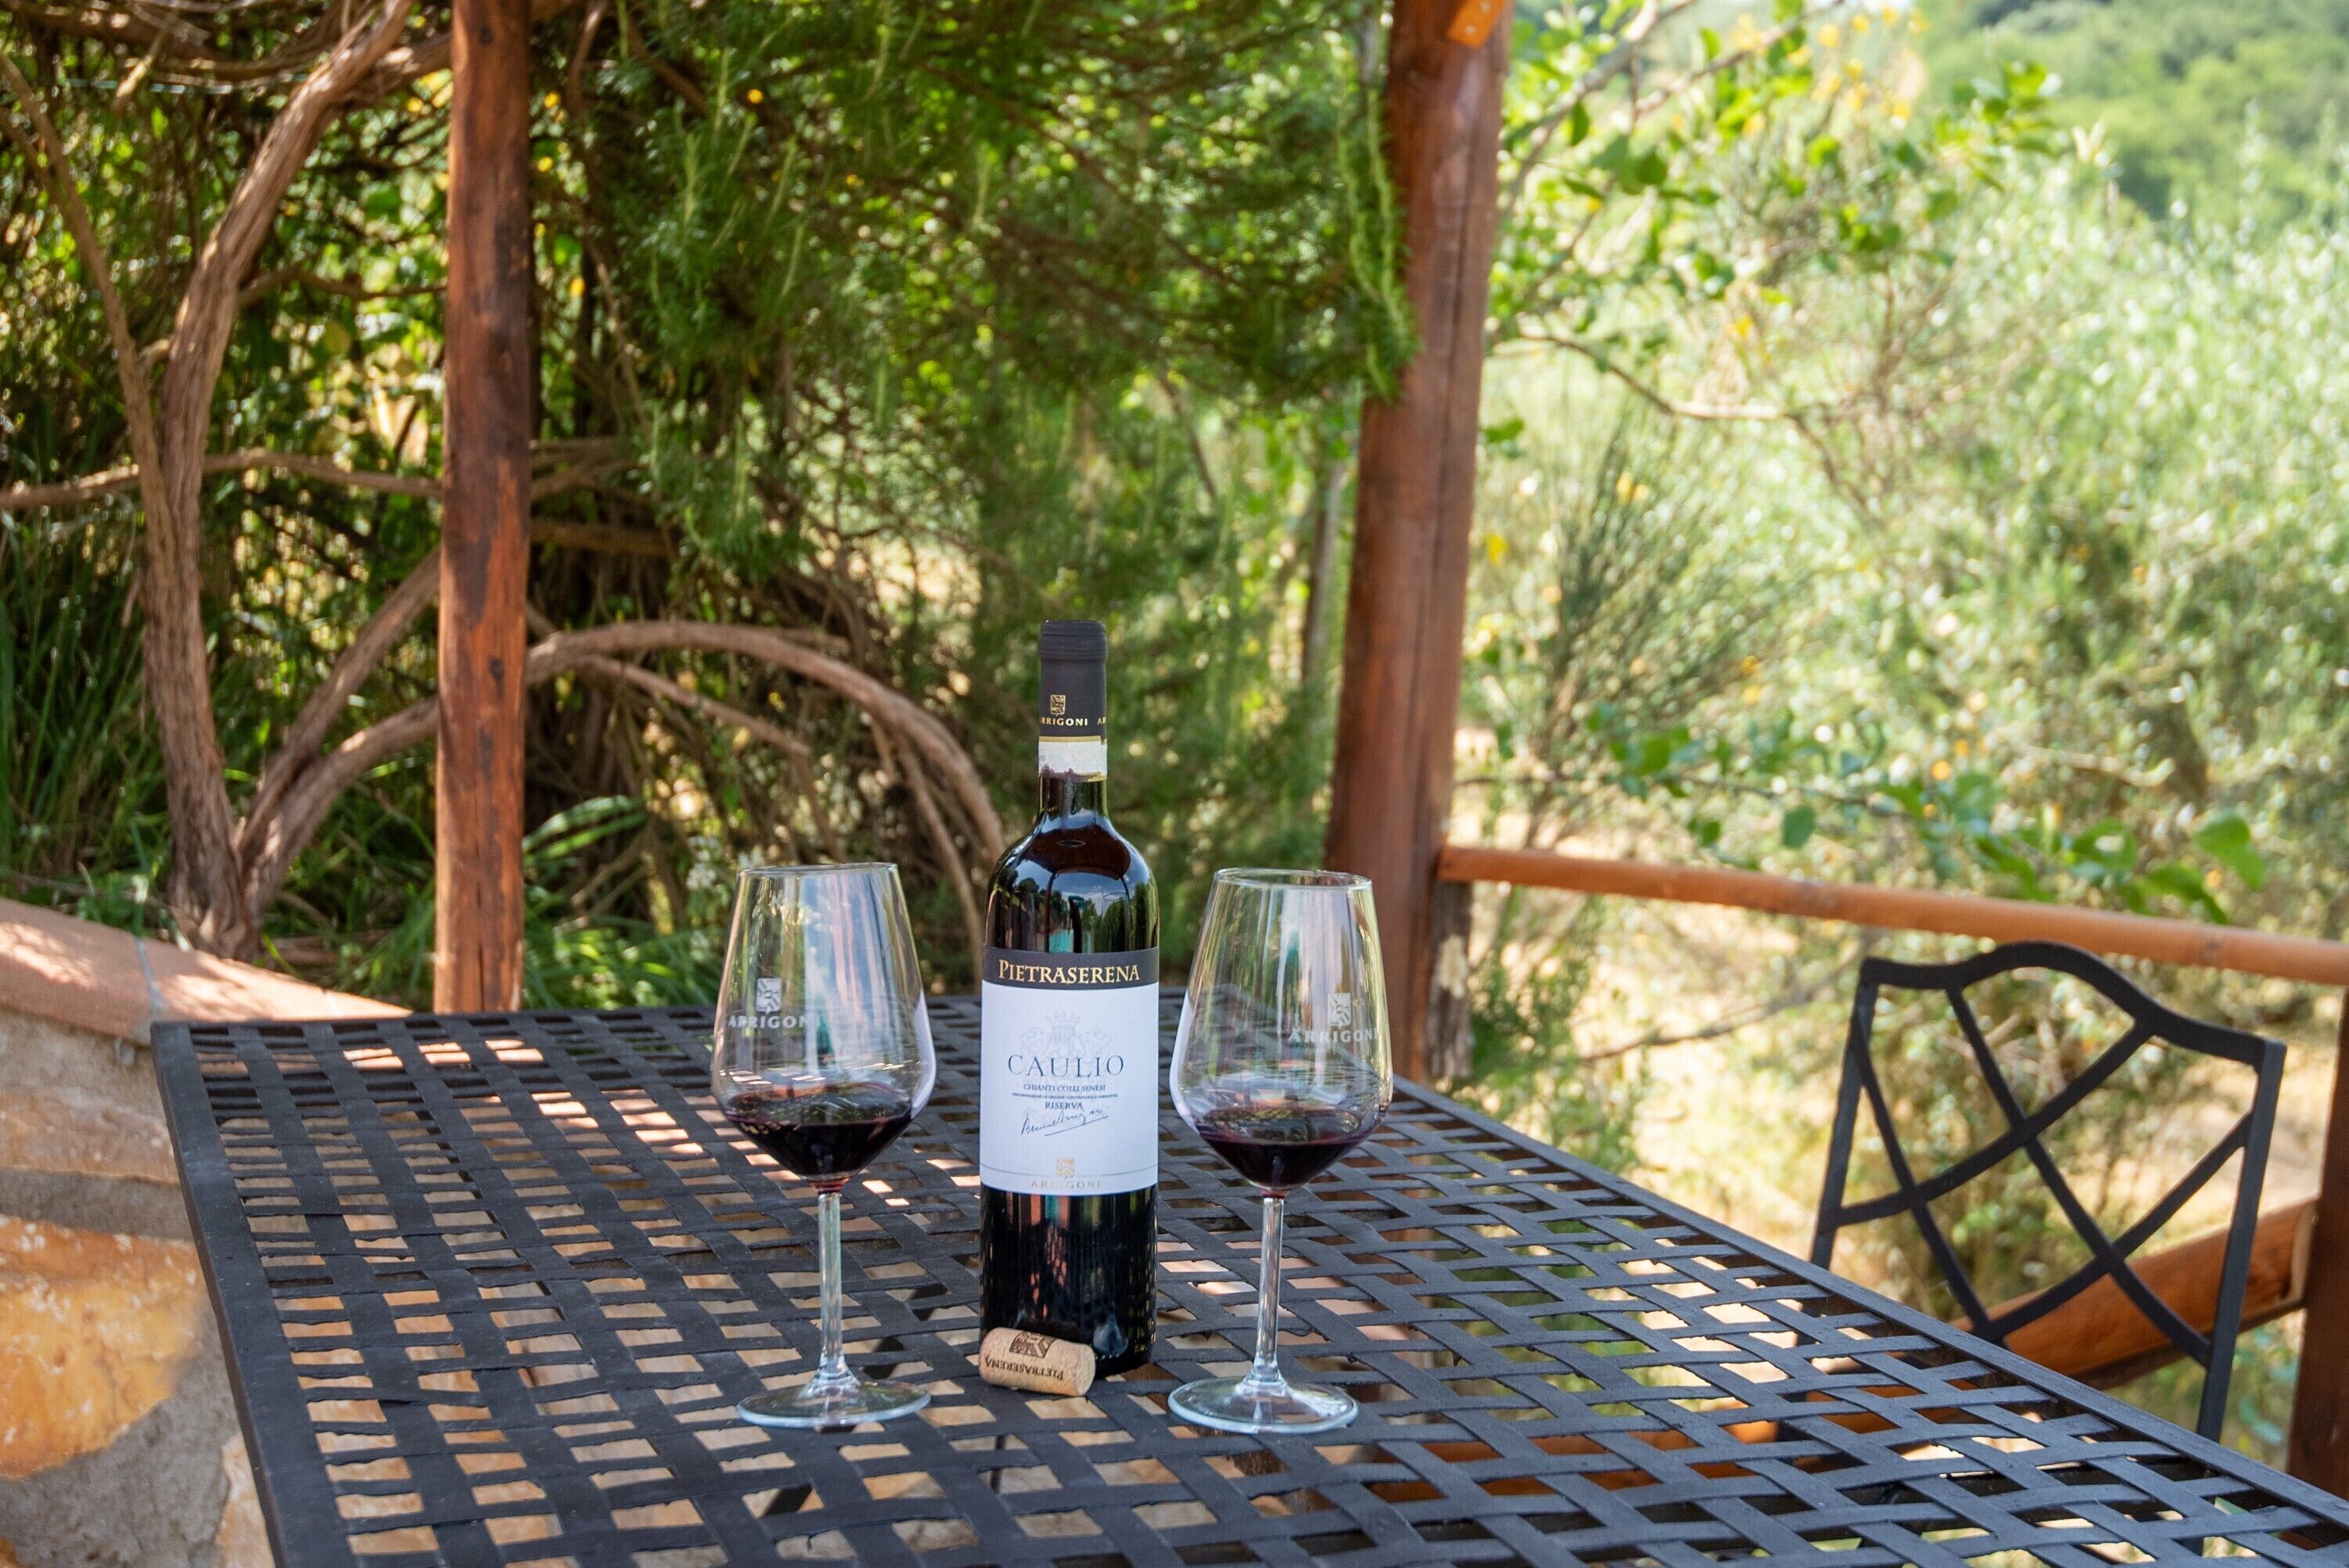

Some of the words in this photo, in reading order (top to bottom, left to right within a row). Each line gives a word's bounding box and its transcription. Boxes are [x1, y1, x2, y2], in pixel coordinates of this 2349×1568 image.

[1040, 716, 1088, 726] RRIGONI
[998, 959, 1141, 985] PIETRASERENA
[1008, 1054, 1124, 1078] CAULIO
[1023, 1083, 1055, 1091] CHIANTI
[984, 1354, 1064, 1380] PIETRASERENA
